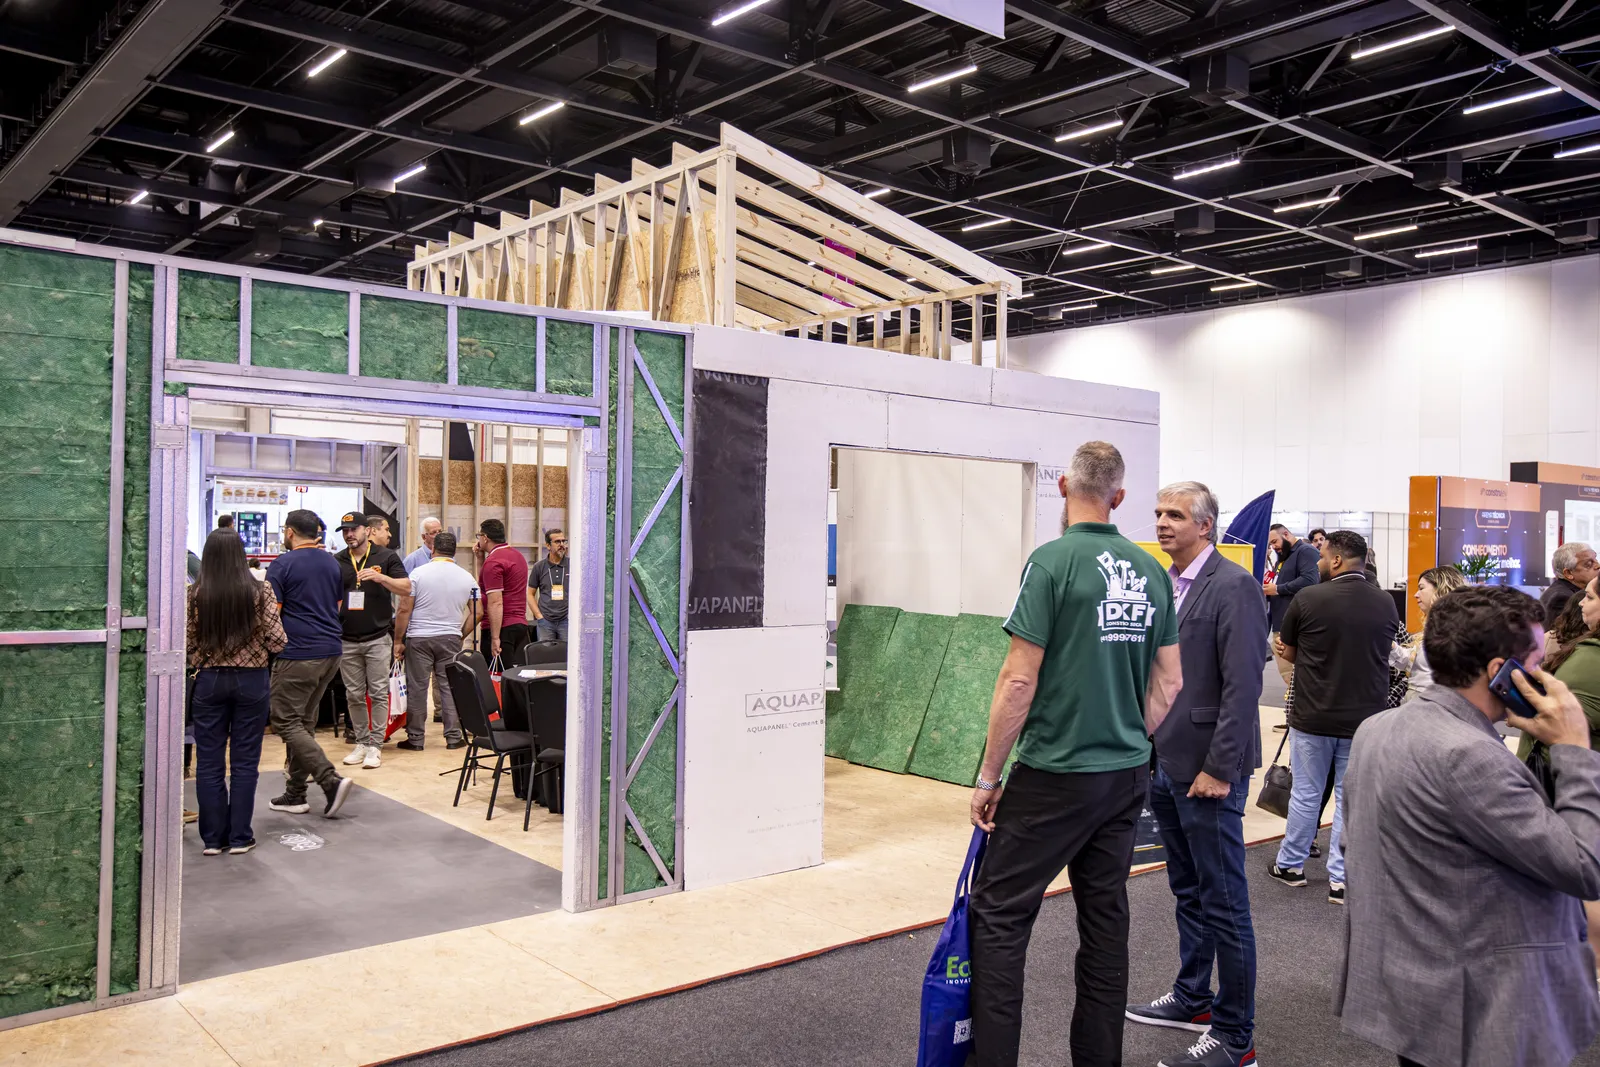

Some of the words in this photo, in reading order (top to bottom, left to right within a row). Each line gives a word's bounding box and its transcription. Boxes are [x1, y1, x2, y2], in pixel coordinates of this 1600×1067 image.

[1105, 603, 1147, 621] DKF
[792, 719, 818, 728] Cement
[947, 956, 971, 978] Ec
